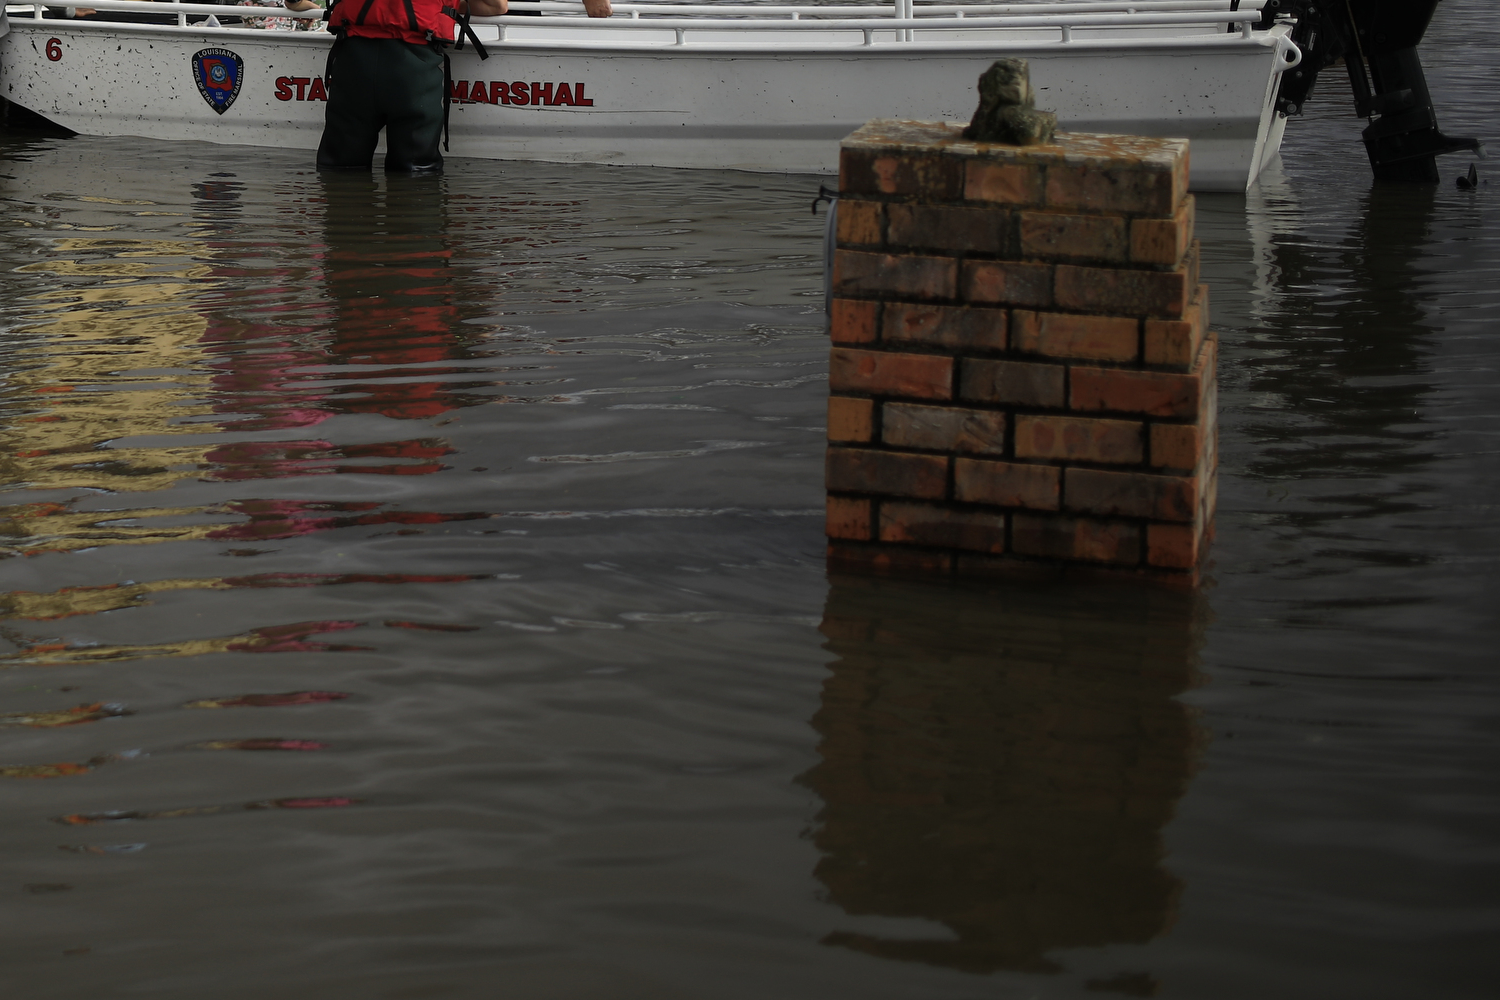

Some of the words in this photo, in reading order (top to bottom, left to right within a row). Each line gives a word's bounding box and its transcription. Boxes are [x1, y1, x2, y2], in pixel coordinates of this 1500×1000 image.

[45, 37, 62, 62] 6
[197, 48, 237, 60] LOUISIANA
[202, 90, 216, 106] STATE
[225, 94, 236, 107] FIRE
[234, 64, 243, 93] MARSHAL
[273, 76, 329, 101] STA
[450, 80, 594, 107] MARSHAL
